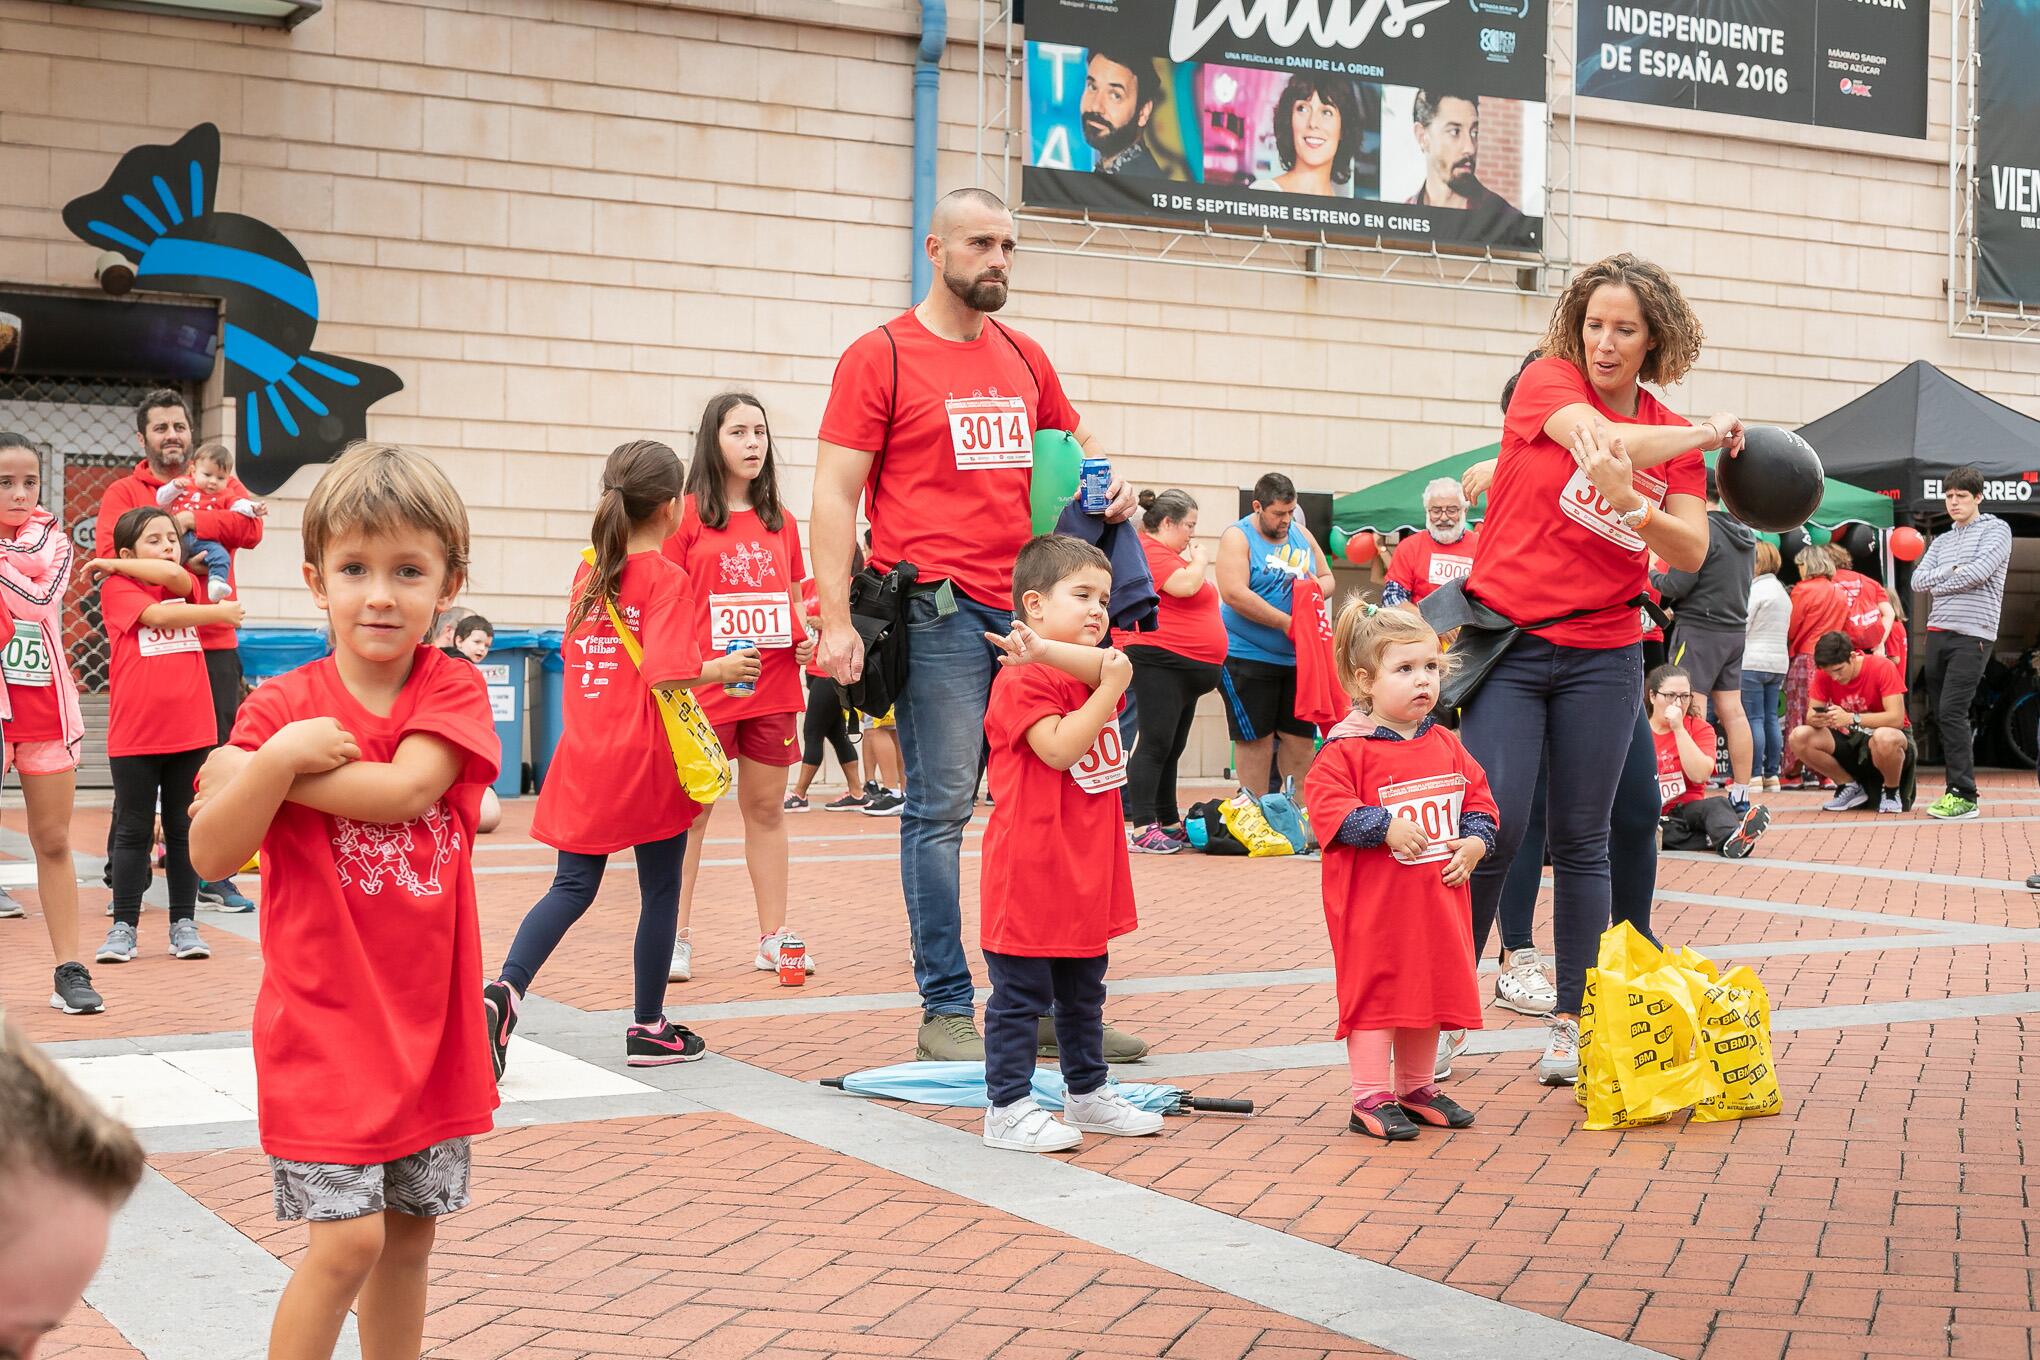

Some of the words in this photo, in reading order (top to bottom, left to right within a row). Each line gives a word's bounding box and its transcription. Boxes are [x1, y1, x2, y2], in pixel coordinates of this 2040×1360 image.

[1606, 4, 1785, 56] INDEPENDIENTE
[1286, 55, 1313, 69] DANI
[1314, 60, 1330, 71] DE
[1331, 62, 1346, 73] LA
[1348, 63, 1384, 77] ORDEN
[1827, 48, 1860, 61] MÁXIMO
[1860, 54, 1887, 66] SABOR
[1600, 44, 1632, 72] DE
[1639, 49, 1729, 86] ESPAÑA
[1735, 62, 1788, 95] 2016
[1827, 60, 1849, 71] ZERO
[1849, 63, 1881, 76] AZÚCAR
[1151, 193, 1168, 208] 13
[1172, 196, 1192, 211] DE
[1196, 198, 1289, 221] SEPTIEMBRE
[1292, 207, 1361, 227] ESTRENO
[1364, 213, 1384, 229] EN
[1387, 215, 1431, 234] CINES
[960, 415, 1024, 450] 3014
[1923, 479, 1946, 500] EL
[1982, 480, 2032, 501] RREO
[720, 607, 779, 636] 3001
[588, 645, 617, 654] Bilbao
[589, 635, 623, 647] Seguros
[1722, 1010, 1739, 1025] BM
[1631, 1022, 1648, 1037] BM
[1730, 1036, 1748, 1048] BM
[1639, 1050, 1654, 1064] BM
